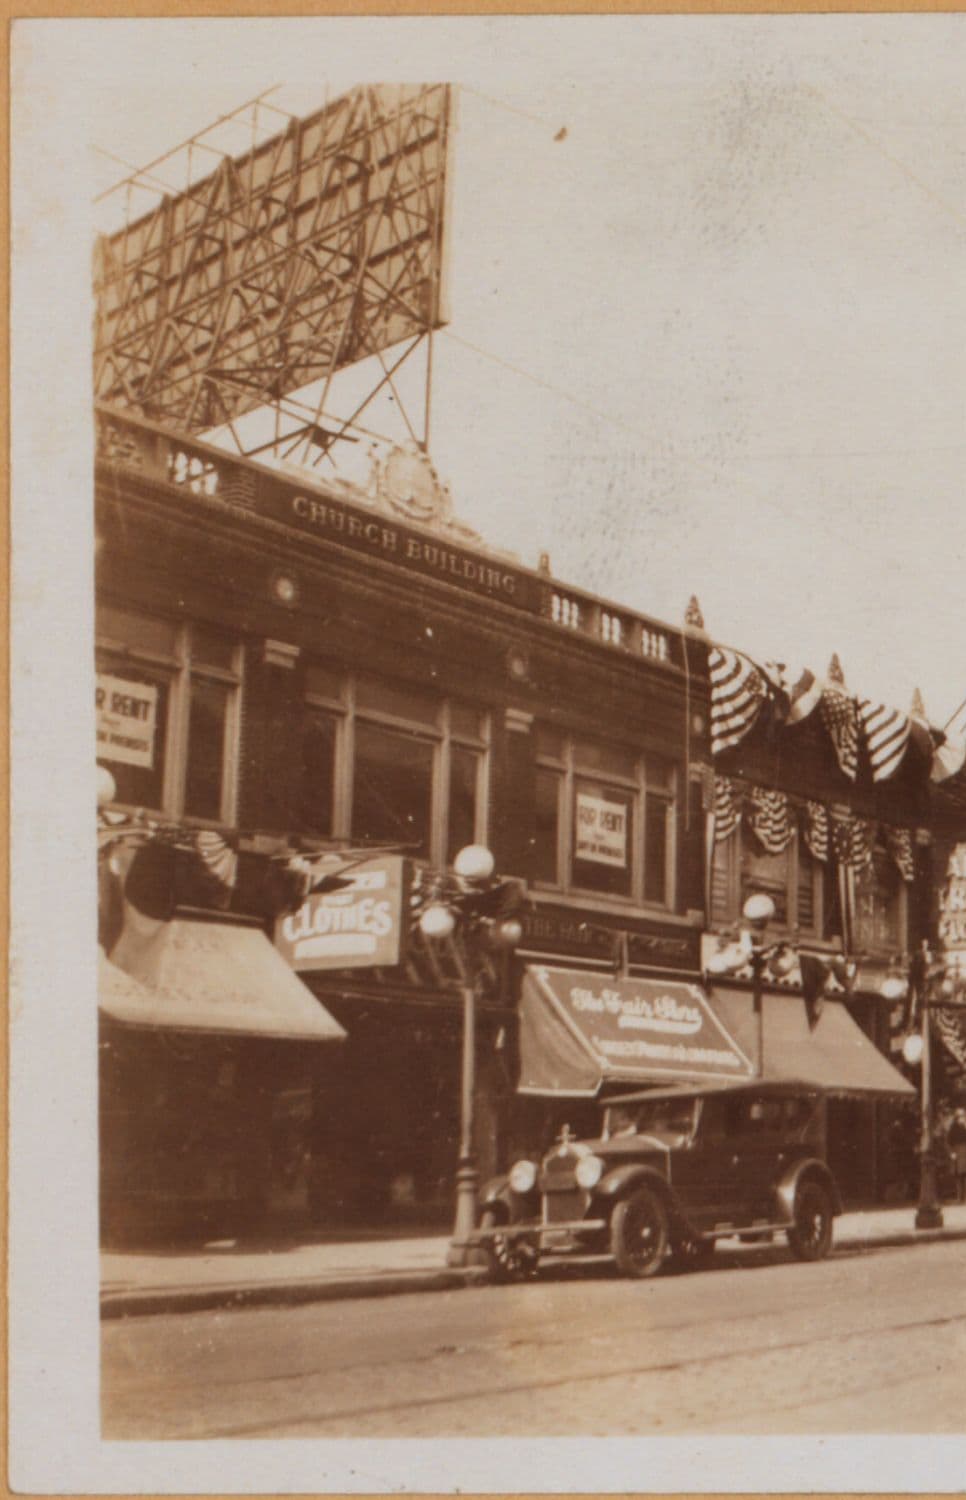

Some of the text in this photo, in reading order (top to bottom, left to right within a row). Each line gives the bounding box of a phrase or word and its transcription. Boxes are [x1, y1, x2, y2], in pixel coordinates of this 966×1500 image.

[291, 497, 516, 594] CHURCH BUILDING
[282, 899, 393, 942] CLOTHES
